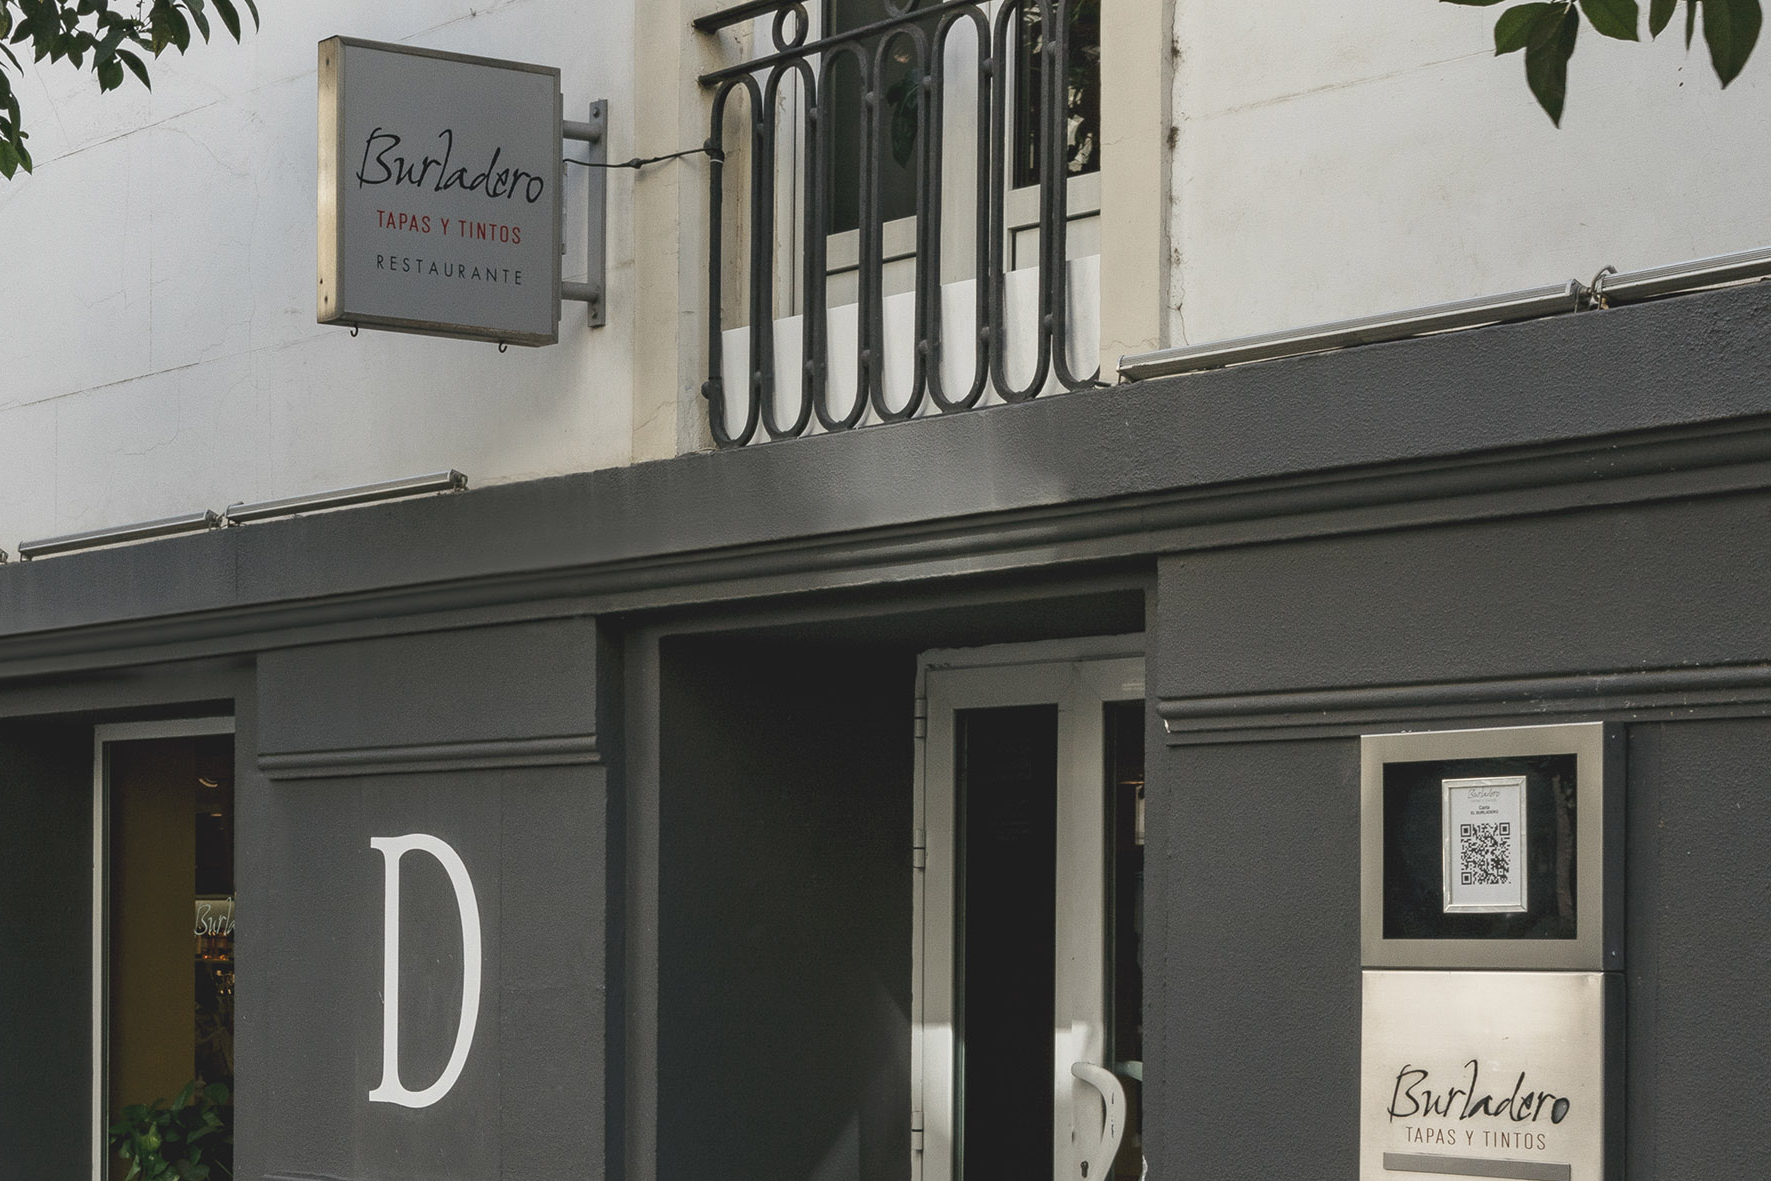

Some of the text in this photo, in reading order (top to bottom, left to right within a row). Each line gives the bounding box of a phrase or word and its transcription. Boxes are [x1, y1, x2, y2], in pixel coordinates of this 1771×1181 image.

[356, 127, 544, 204] Burladero
[377, 210, 522, 244] TAPAS Y TINTOS
[377, 254, 522, 286] RESTAURANTE
[1386, 1059, 1571, 1124] Burladero
[1405, 1126, 1546, 1151] TAPAS Y TINTOS
